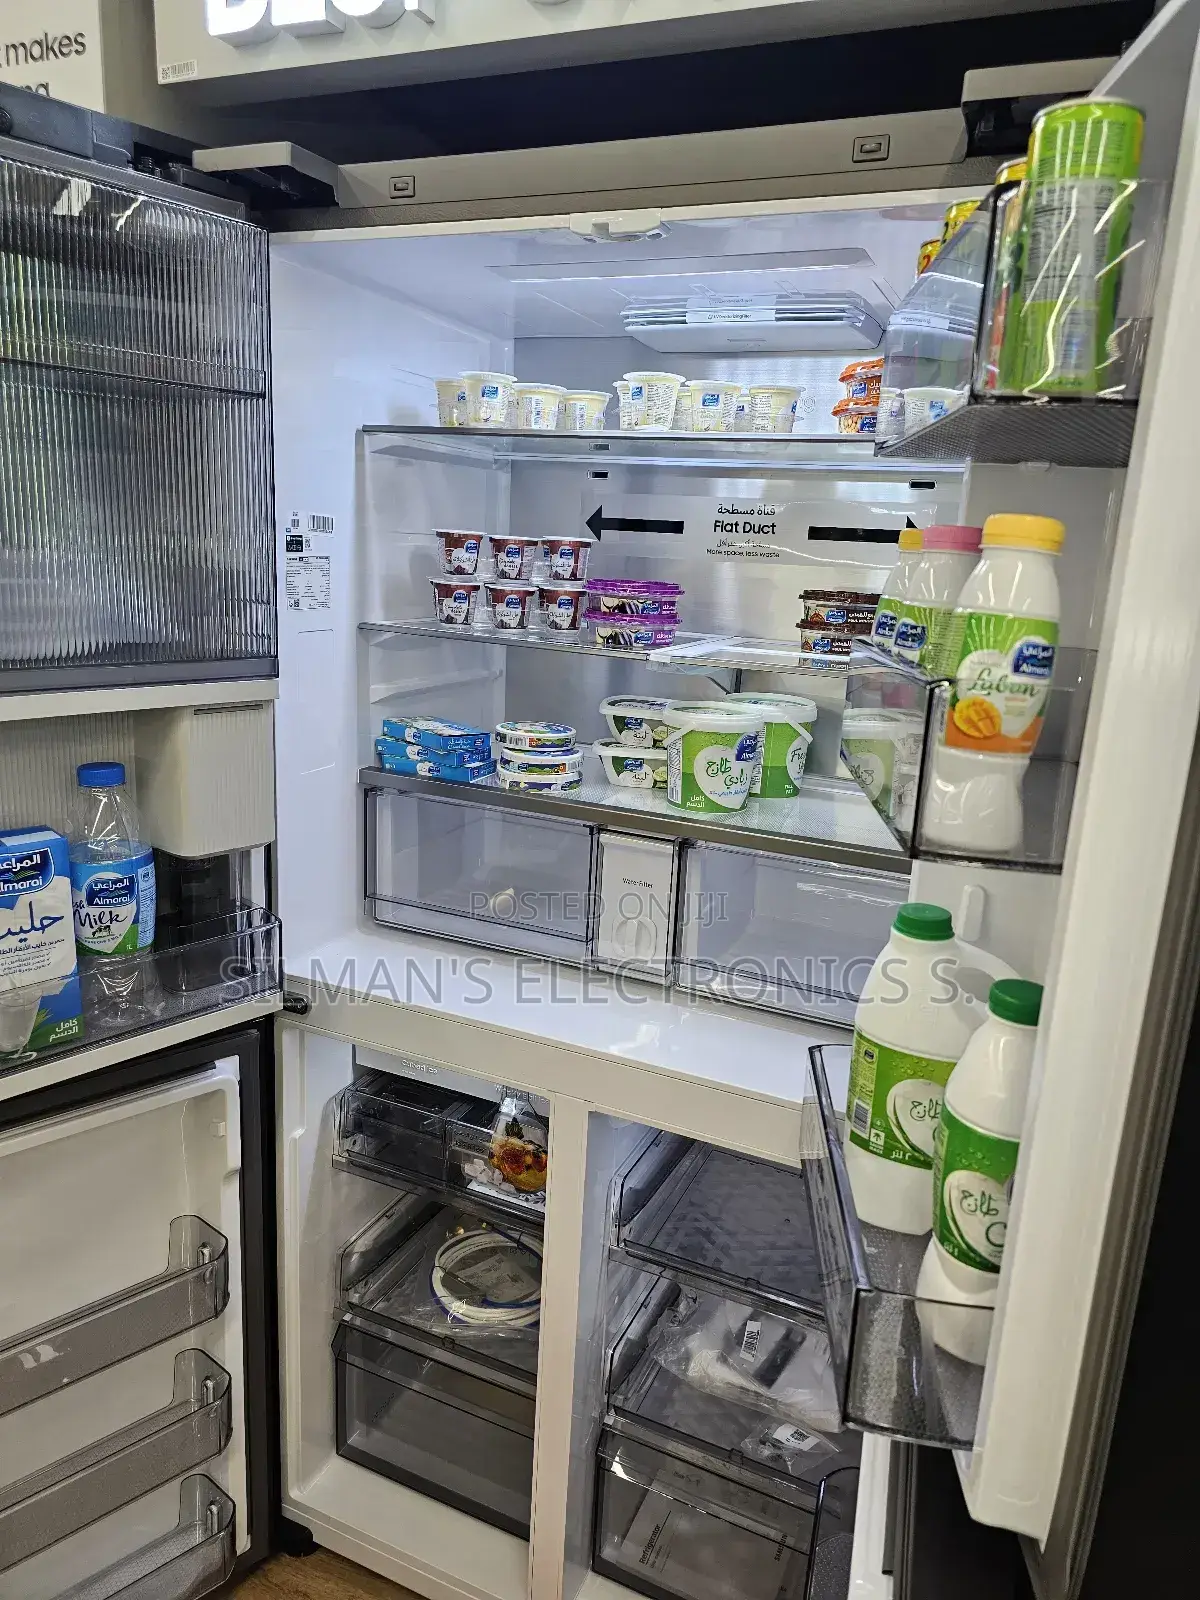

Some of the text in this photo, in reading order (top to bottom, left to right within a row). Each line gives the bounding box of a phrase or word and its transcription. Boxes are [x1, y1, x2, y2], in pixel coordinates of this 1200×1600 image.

[5, 32, 87, 68] makes
[717, 503, 776, 516] قناة مسطحة
[713, 519, 777, 535] Flat Duct
[705, 756, 732, 778] طازج
[723, 768, 748, 790] زبادي
[686, 801, 705, 809] الدسم
[690, 795, 705, 803] كامل
[0, 875, 43, 893] lmarai
[92, 877, 130, 891] المراعي
[92, 894, 130, 906] Almarai
[73, 909, 128, 930] Milk
[55, 1018, 78, 1032] كامل
[49, 1026, 79, 1042] الدسم
[960, 1189, 1000, 1218] طازج
[638, 1523, 661, 1565] Refrigerator
[774, 1534, 789, 1562] SAMSUN
